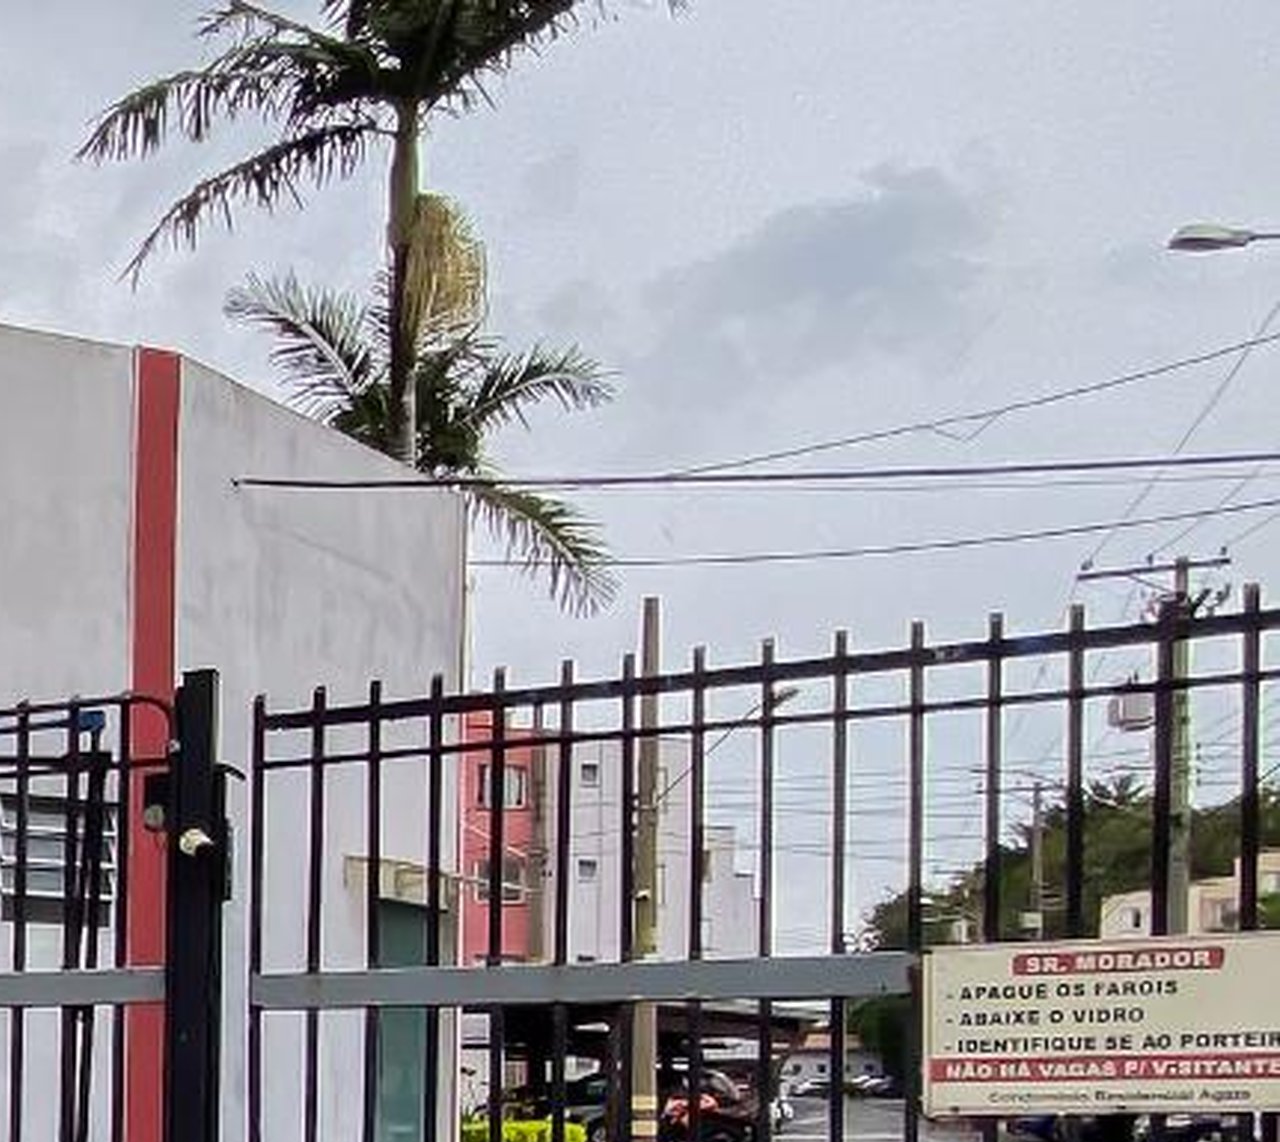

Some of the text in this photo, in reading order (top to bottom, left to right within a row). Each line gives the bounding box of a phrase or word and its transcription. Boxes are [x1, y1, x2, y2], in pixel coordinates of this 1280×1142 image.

[1026, 951, 1211, 973] SR. MORADOR
[960, 984, 1047, 1000] APAGUE
[1056, 983, 1085, 997] OS
[960, 1007, 1144, 1026] ABAIXE O VIDRO
[958, 1037, 1096, 1053] IDENTIFIQUE
[1105, 1036, 1132, 1050] SE
[1142, 1034, 1171, 1049] AO
[946, 1060, 992, 1078] NÃO
[1039, 1061, 1117, 1077] VAGAS
